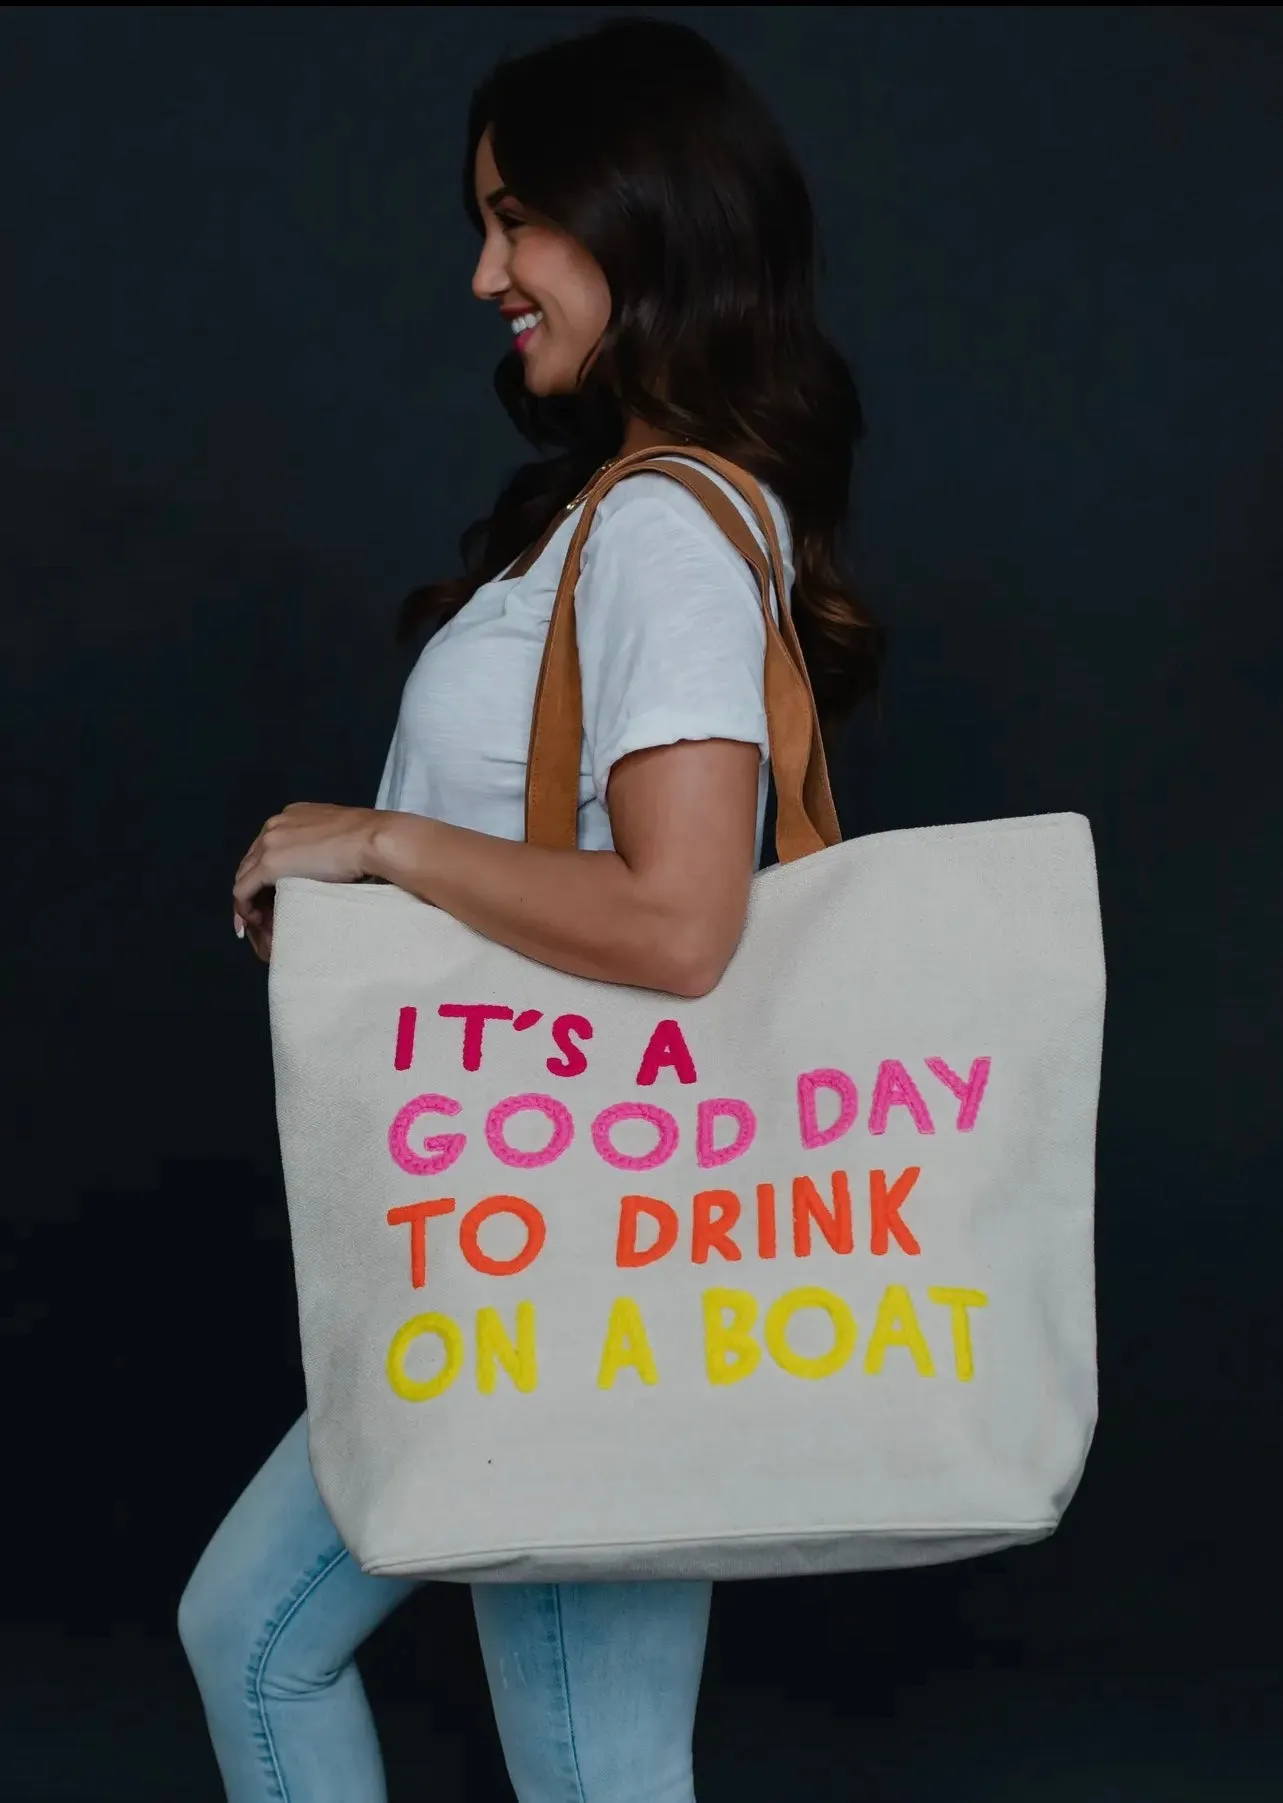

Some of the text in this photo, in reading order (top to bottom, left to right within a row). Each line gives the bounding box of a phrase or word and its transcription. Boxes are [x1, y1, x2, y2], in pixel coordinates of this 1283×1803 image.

[393, 1004, 698, 1087] IT'S A
[387, 1057, 992, 1176] GOOD DAY
[386, 1166, 922, 1289] TO DRINK
[386, 1284, 989, 1403] ON A BOAT
